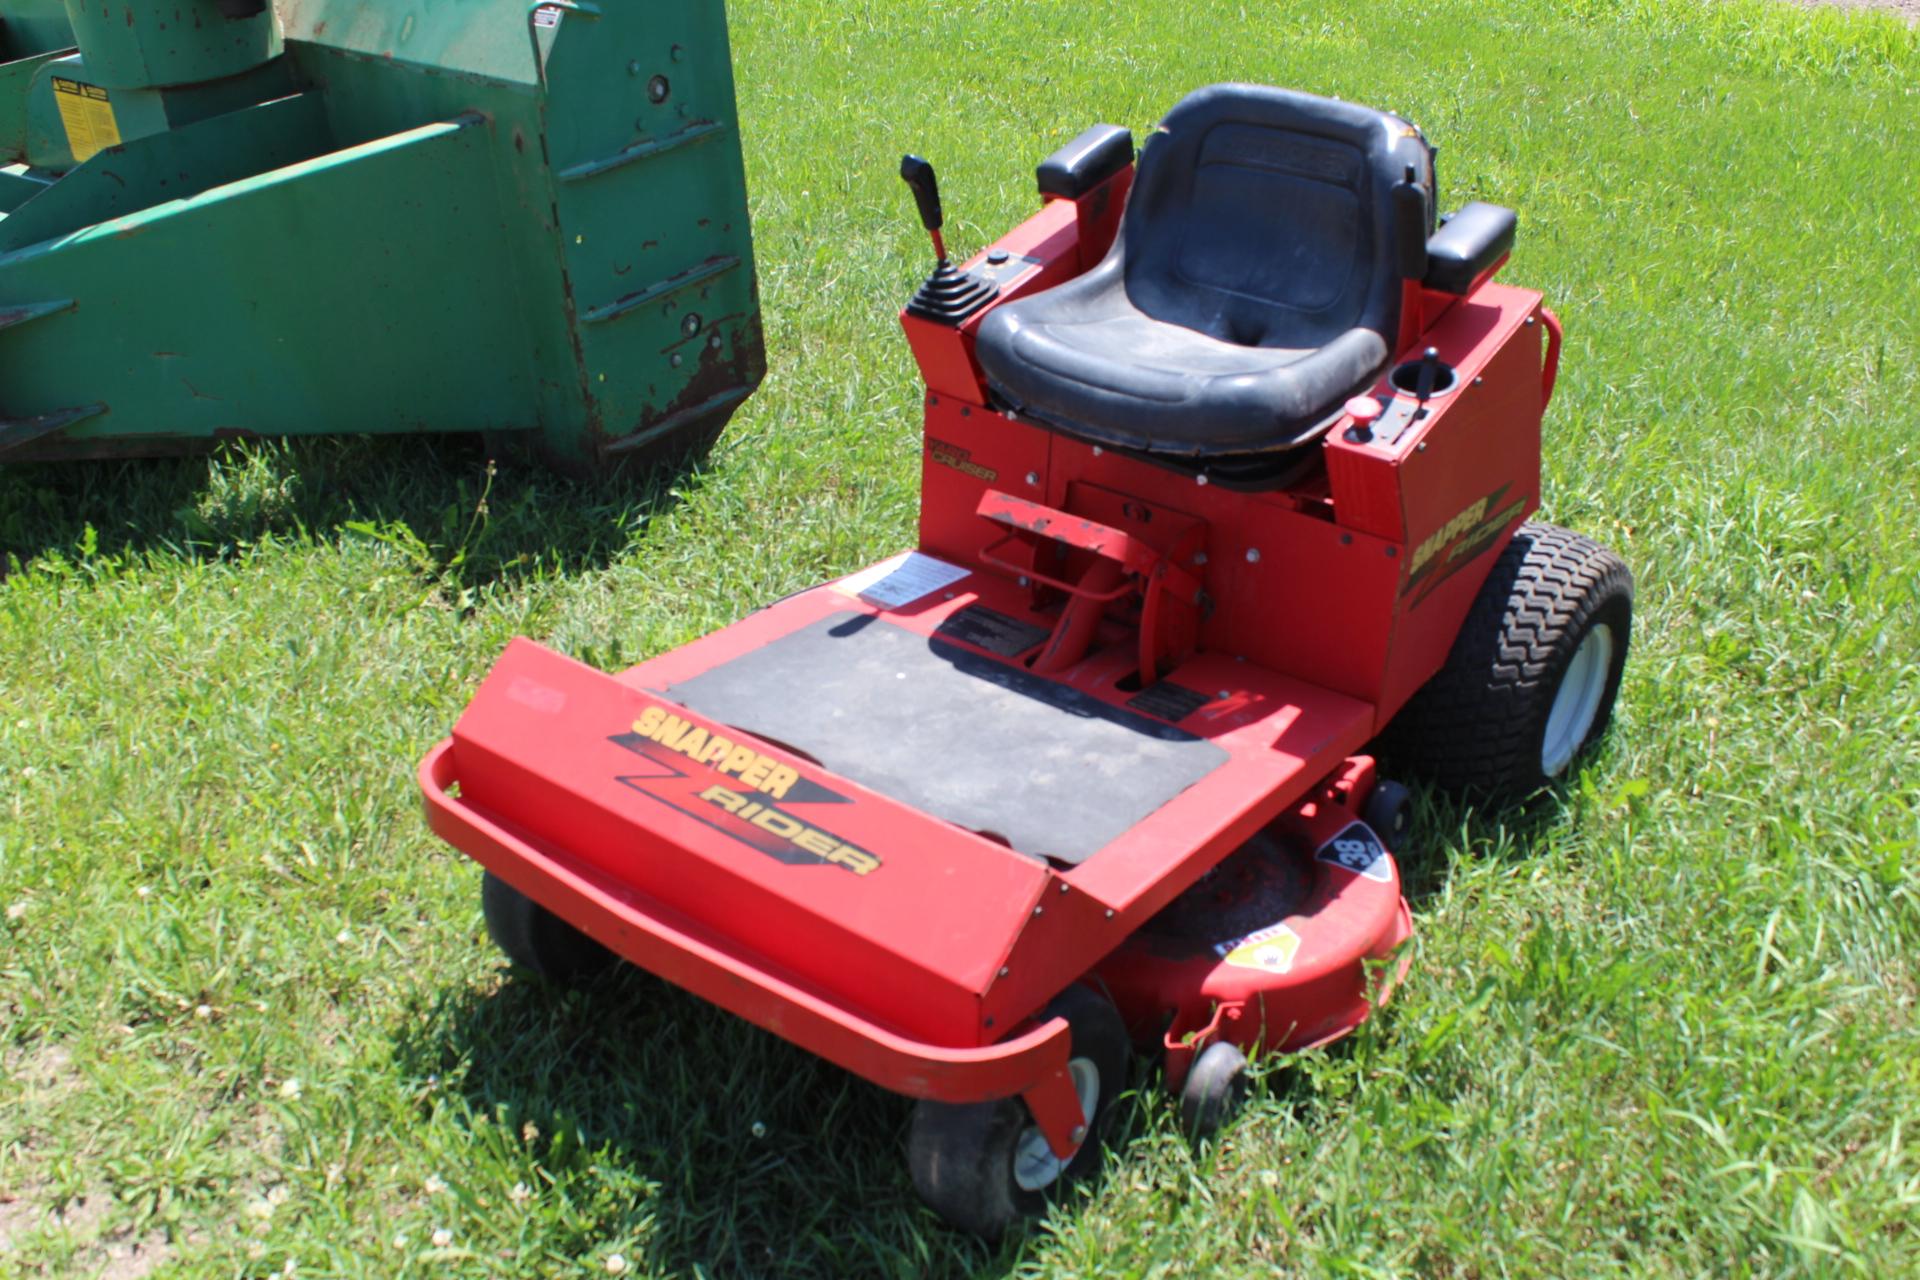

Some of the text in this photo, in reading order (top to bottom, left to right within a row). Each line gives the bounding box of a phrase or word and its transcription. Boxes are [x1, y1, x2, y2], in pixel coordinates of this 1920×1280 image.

[932, 450, 997, 482] CRUISER
[1409, 496, 1488, 575] SNAPPER
[632, 706, 799, 800] SNAPPER
[699, 784, 882, 876] RIDER
[1334, 839, 1371, 866] 38
